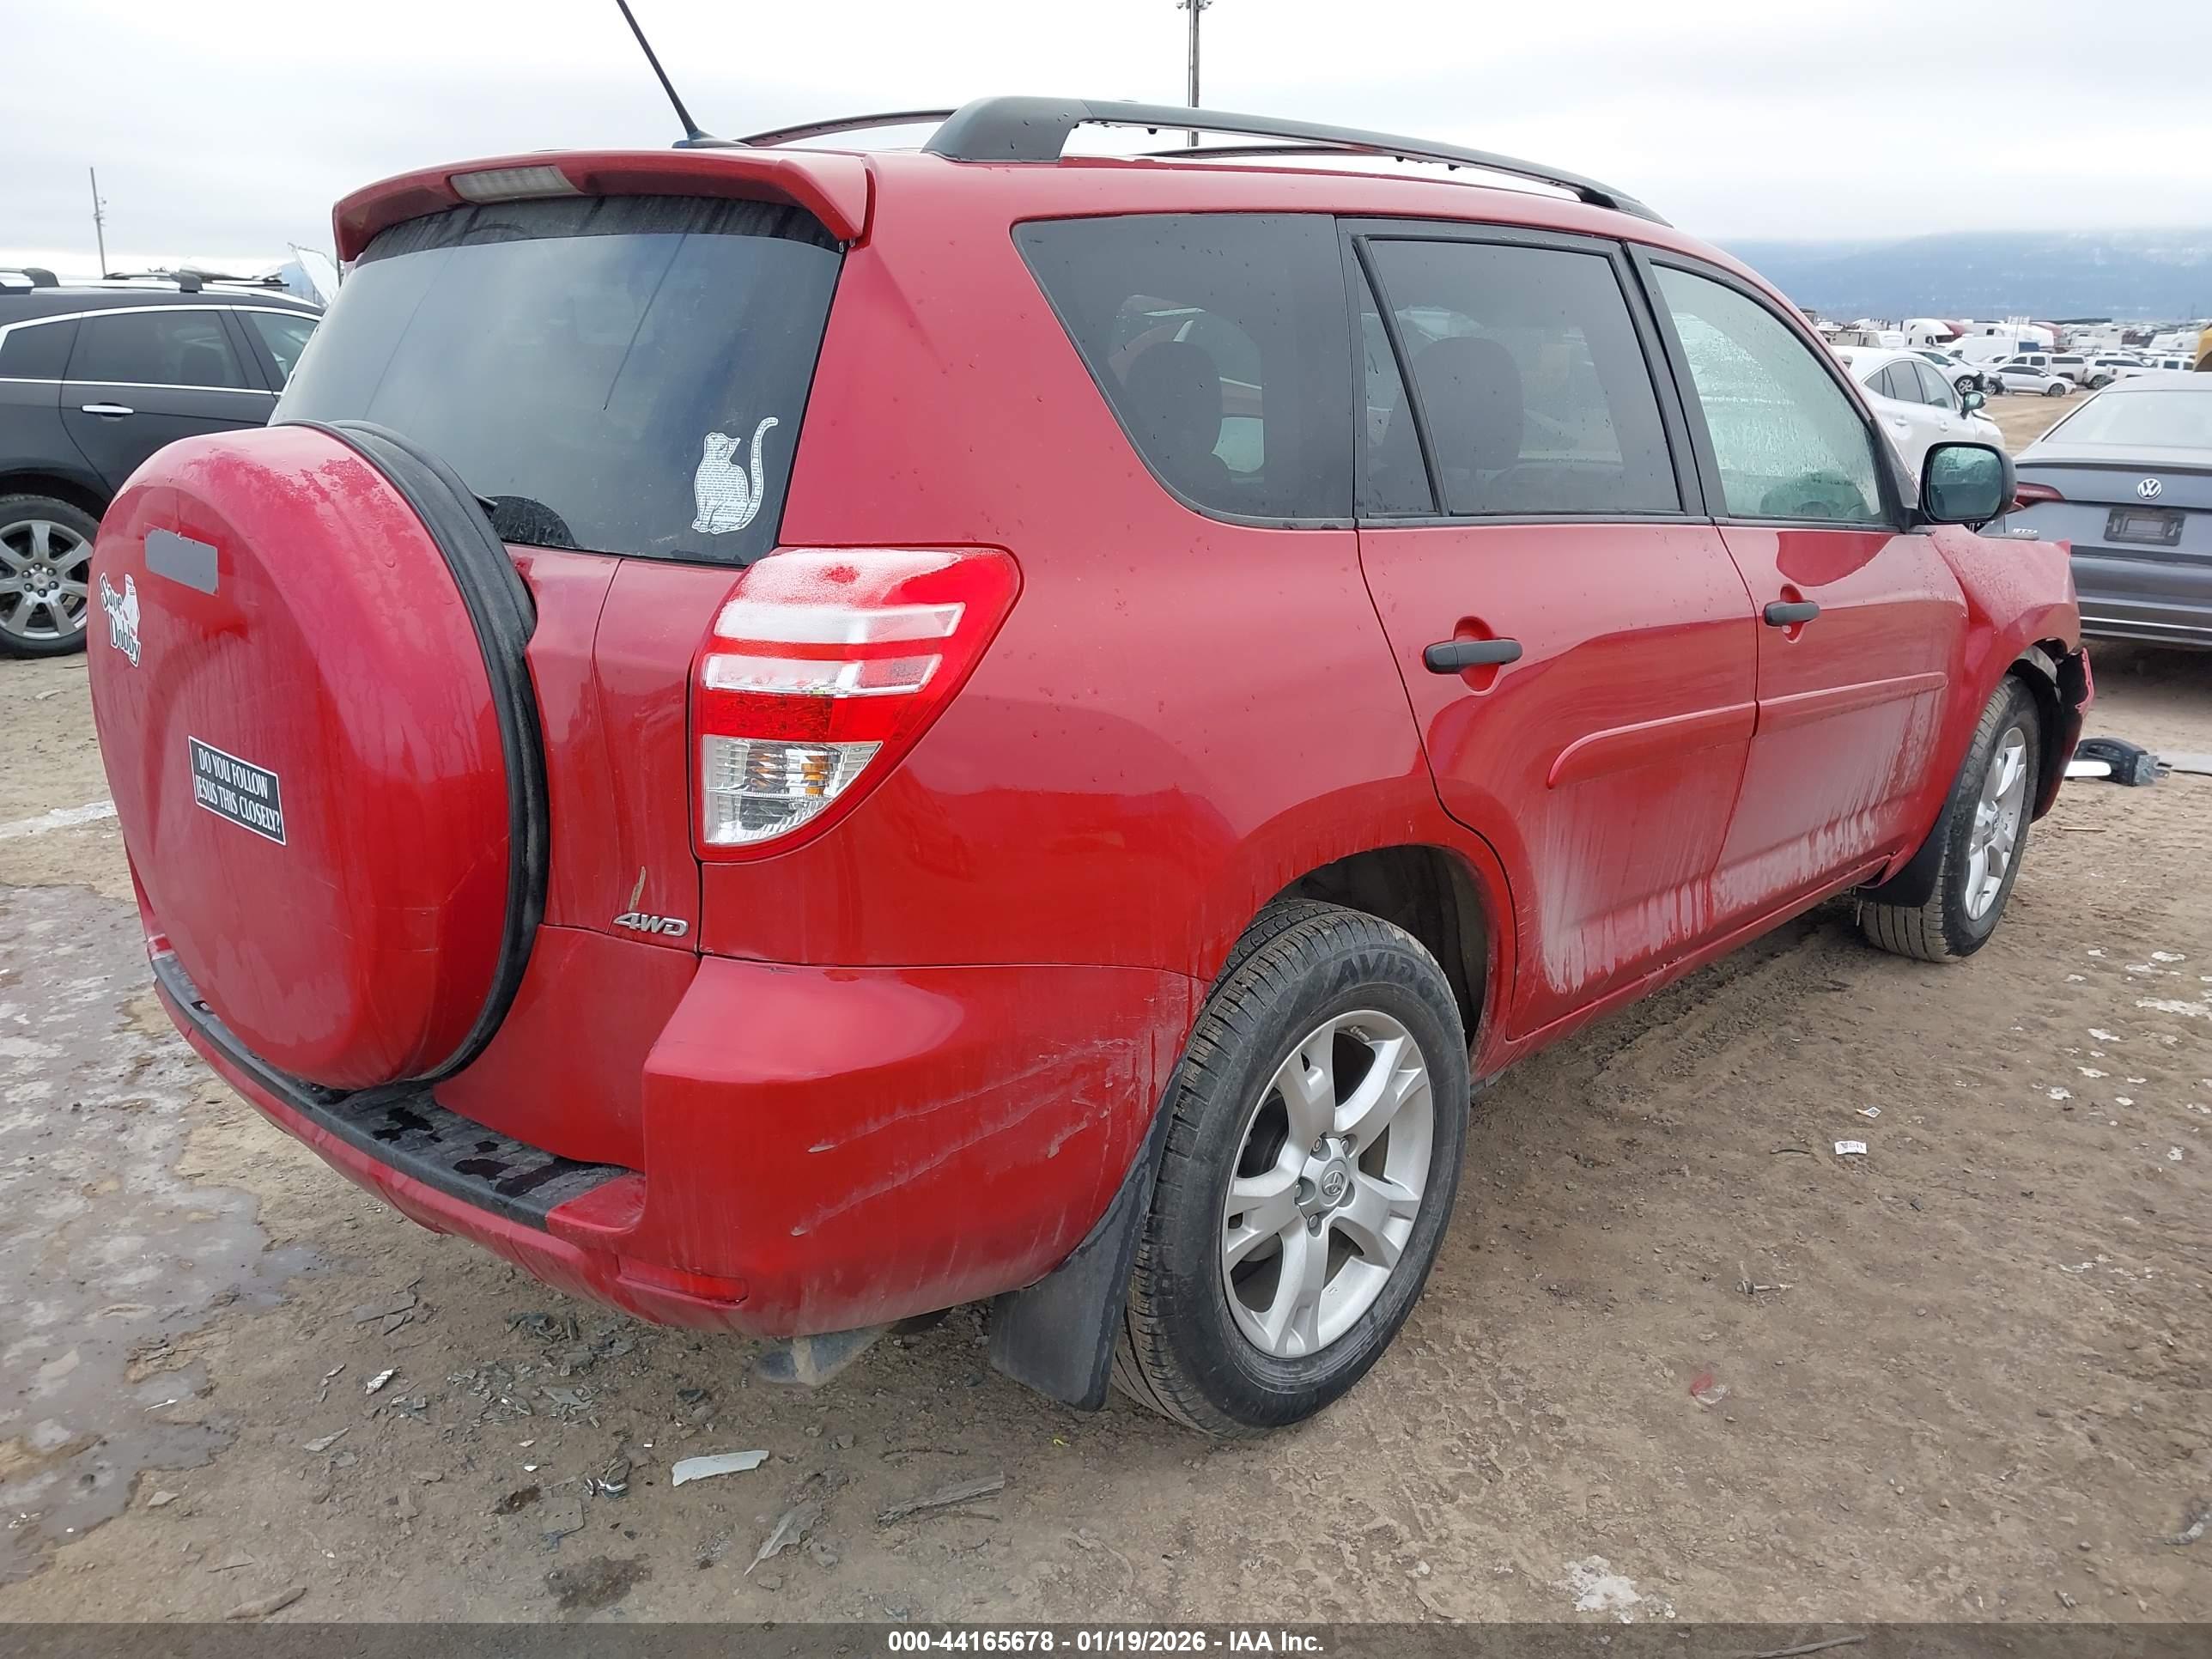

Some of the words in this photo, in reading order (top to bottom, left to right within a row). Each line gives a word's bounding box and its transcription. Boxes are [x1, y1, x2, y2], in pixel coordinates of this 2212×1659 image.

[2137, 477, 2162, 500] VW
[100, 575, 123, 616] Save
[110, 612, 140, 665] Dobby
[198, 747, 212, 775] DO
[211, 753, 231, 784] YOU
[231, 763, 269, 799] FOLLOW
[195, 775, 218, 805] JESUS
[217, 786, 238, 815] THIS
[239, 795, 281, 835] CLOSELY?
[613, 912, 690, 937] 4WD
[1333, 951, 1418, 994] AVID
